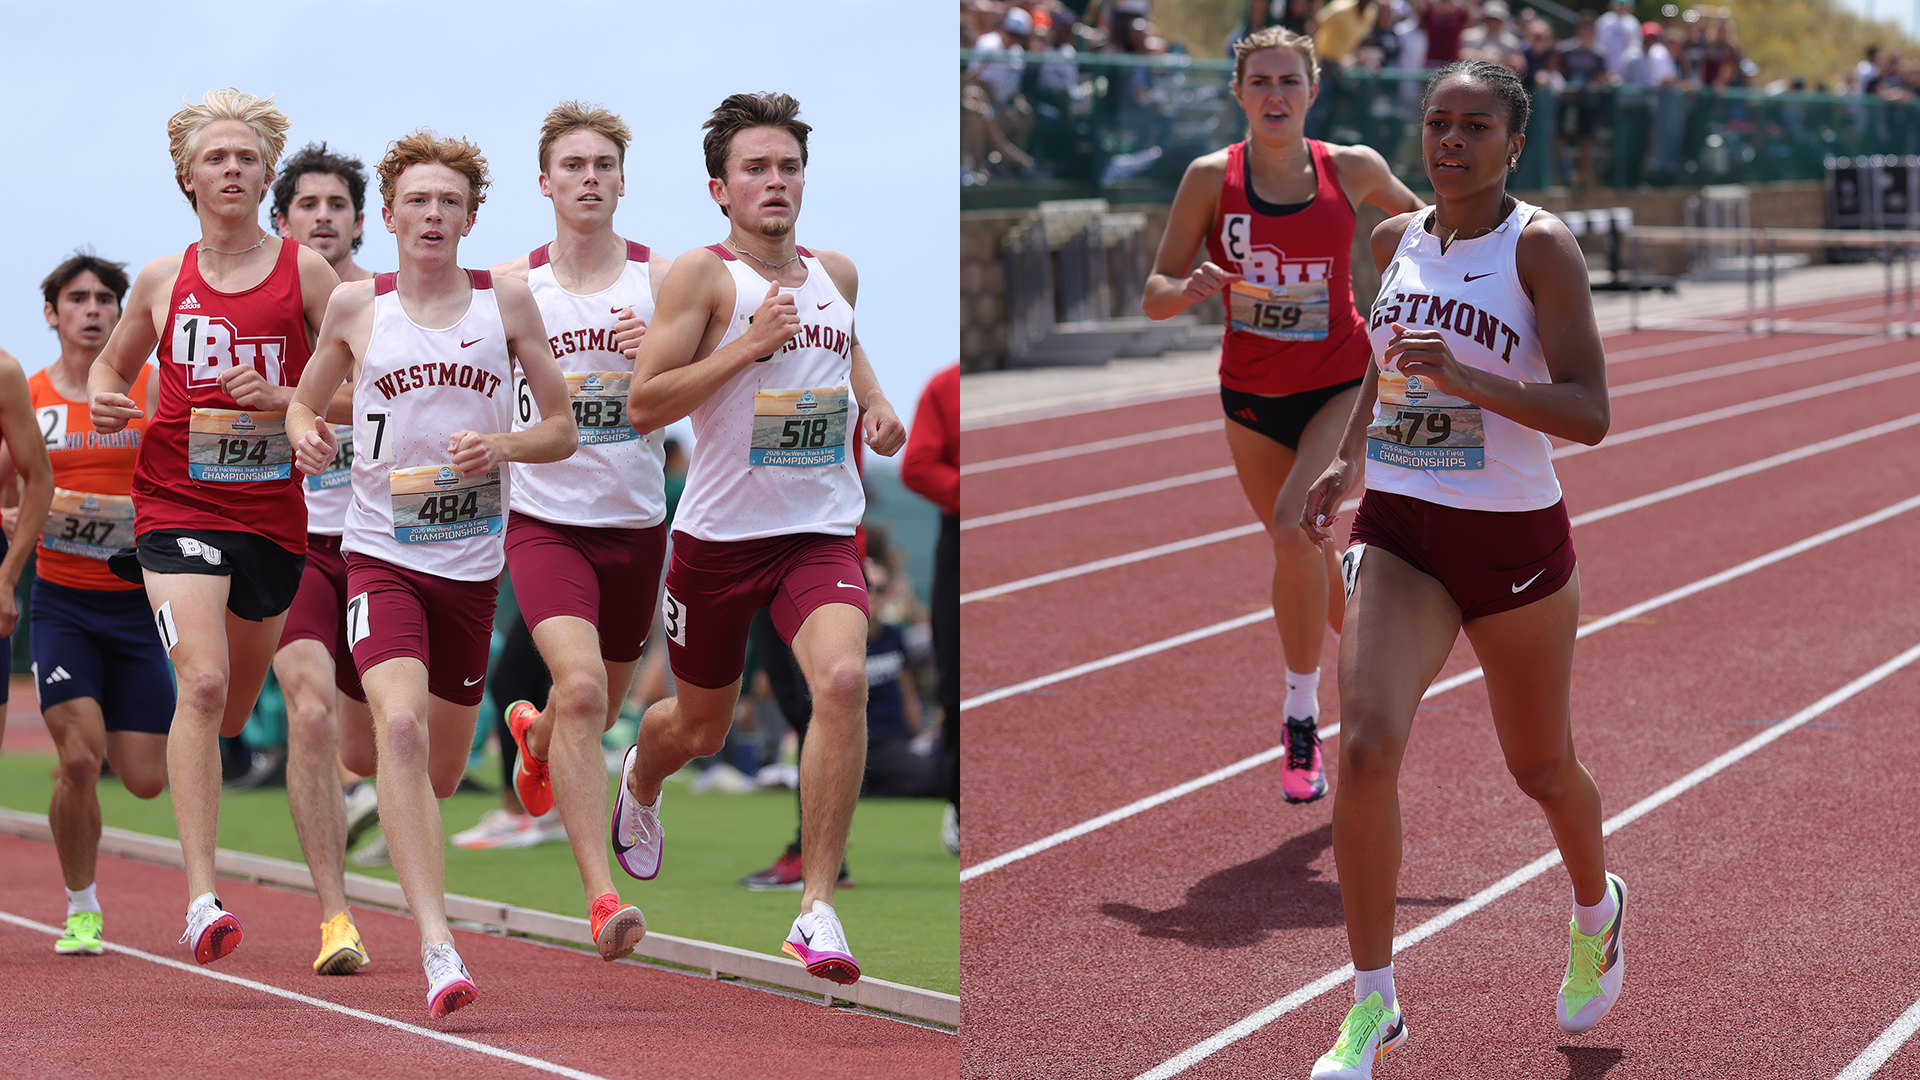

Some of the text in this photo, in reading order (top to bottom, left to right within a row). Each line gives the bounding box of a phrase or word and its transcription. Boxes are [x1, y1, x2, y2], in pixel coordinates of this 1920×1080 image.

[1253, 303, 1302, 329] 159
[1371, 293, 1521, 364] ESTMONT
[183, 318, 199, 362] 1
[549, 328, 625, 359] ESTMO
[374, 362, 502, 401] WESTMONT
[518, 378, 531, 423] 6
[43, 409, 59, 445] 2
[366, 413, 386, 460] 7
[579, 433, 630, 443] PIONSHIPS
[780, 419, 828, 448] 518
[1386, 411, 1451, 446] 479
[218, 438, 268, 465] 194
[763, 455, 836, 465] CHAMPIONSHIPS
[1380, 450, 1467, 468] CHAMPIONSHIPS
[201, 470, 280, 481] CHAMPIONSHIPS
[418, 491, 478, 525] 484
[61, 517, 115, 545] 347
[409, 525, 489, 542] CHAMPIONSHIPS
[176, 537, 222, 566] BU
[158, 609, 171, 648] 1
[348, 597, 361, 644] 7
[666, 595, 679, 638] 3
